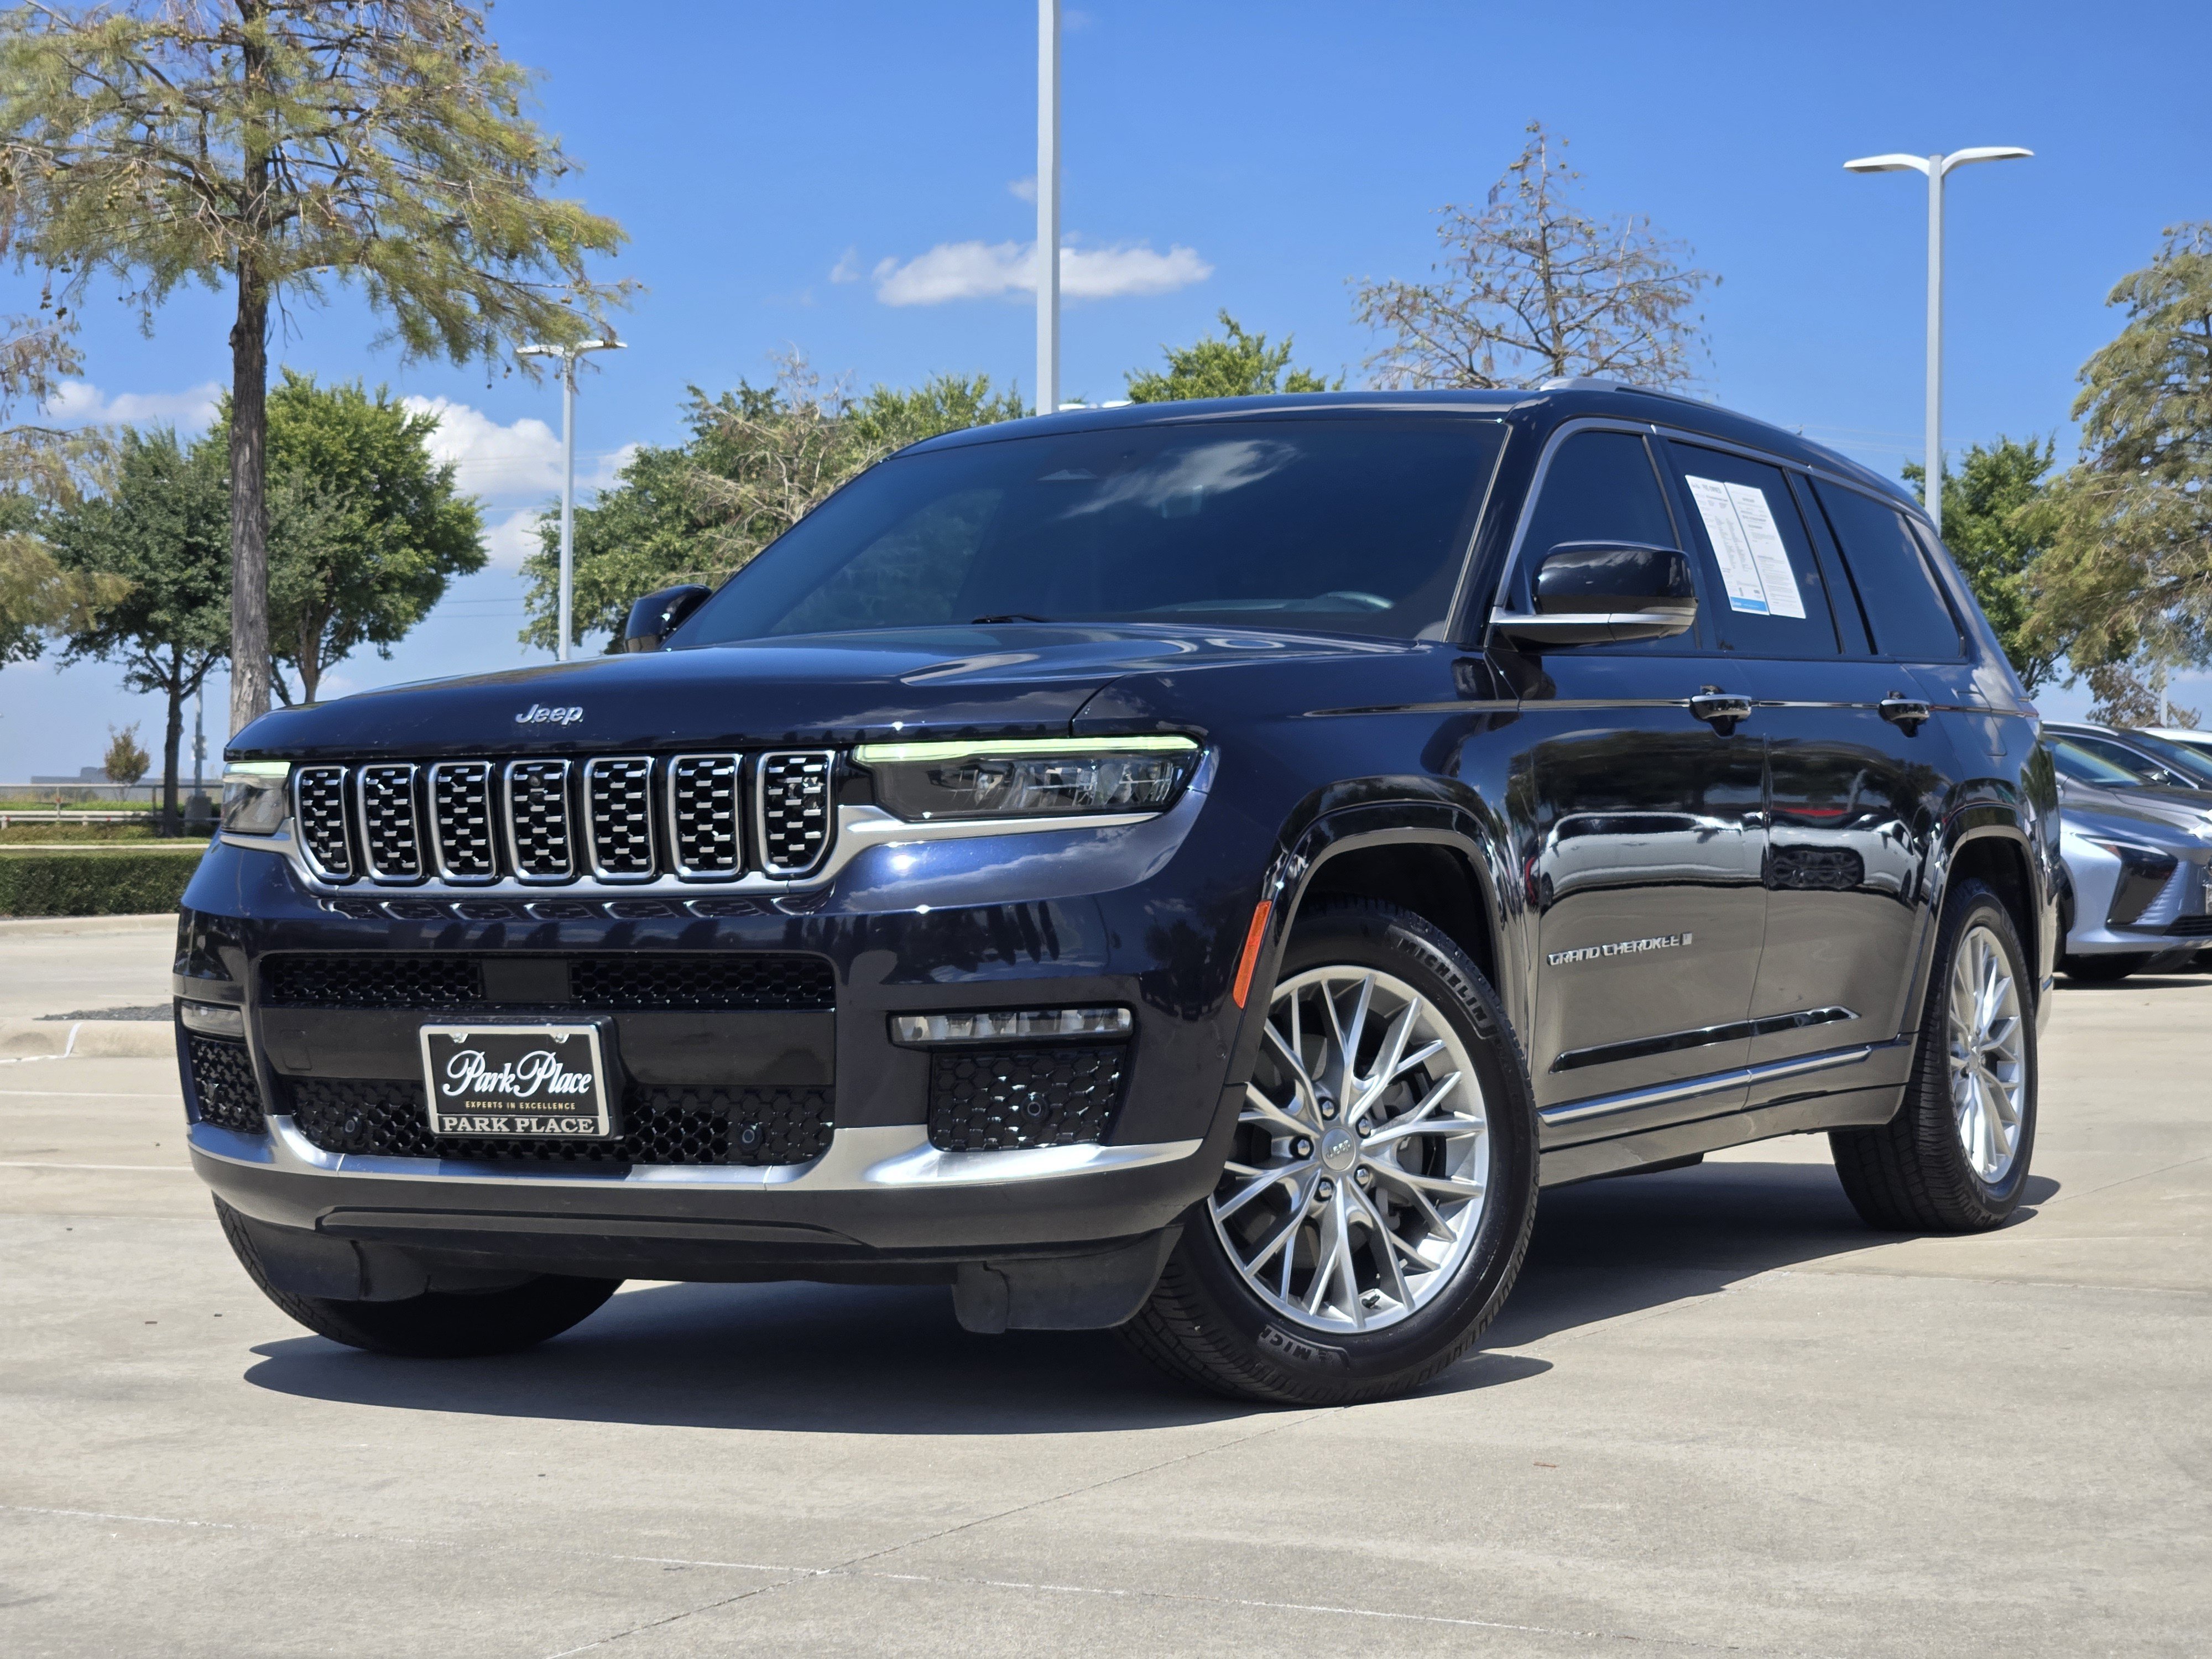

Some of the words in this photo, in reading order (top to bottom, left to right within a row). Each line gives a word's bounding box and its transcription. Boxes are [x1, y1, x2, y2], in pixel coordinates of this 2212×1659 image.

[515, 704, 583, 726] Jeep
[1548, 946, 1600, 966] GRAND
[1397, 939, 1488, 1022] MICHELIN
[442, 1050, 515, 1096] Park
[513, 1050, 592, 1098] Place
[466, 1100, 503, 1109] EXPERTS
[519, 1102, 576, 1110] EXCELLENCE
[443, 1117, 510, 1131] PARK
[514, 1118, 595, 1133] PLACE
